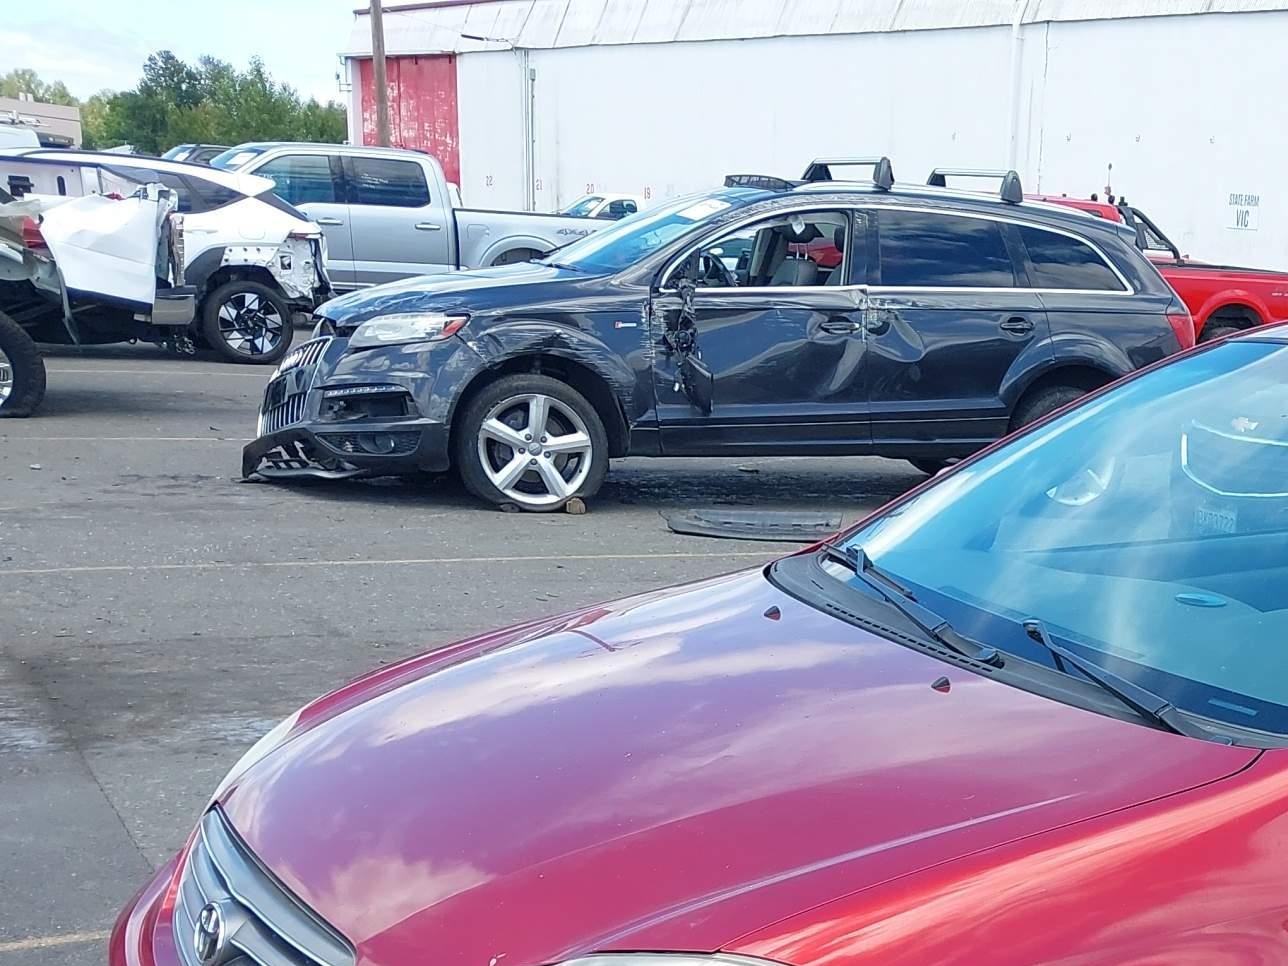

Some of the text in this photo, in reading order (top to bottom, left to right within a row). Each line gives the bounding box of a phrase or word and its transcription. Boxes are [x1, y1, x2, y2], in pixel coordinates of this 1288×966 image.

[1229, 193, 1260, 207] STATE FARM
[1236, 209, 1249, 228] VIC
